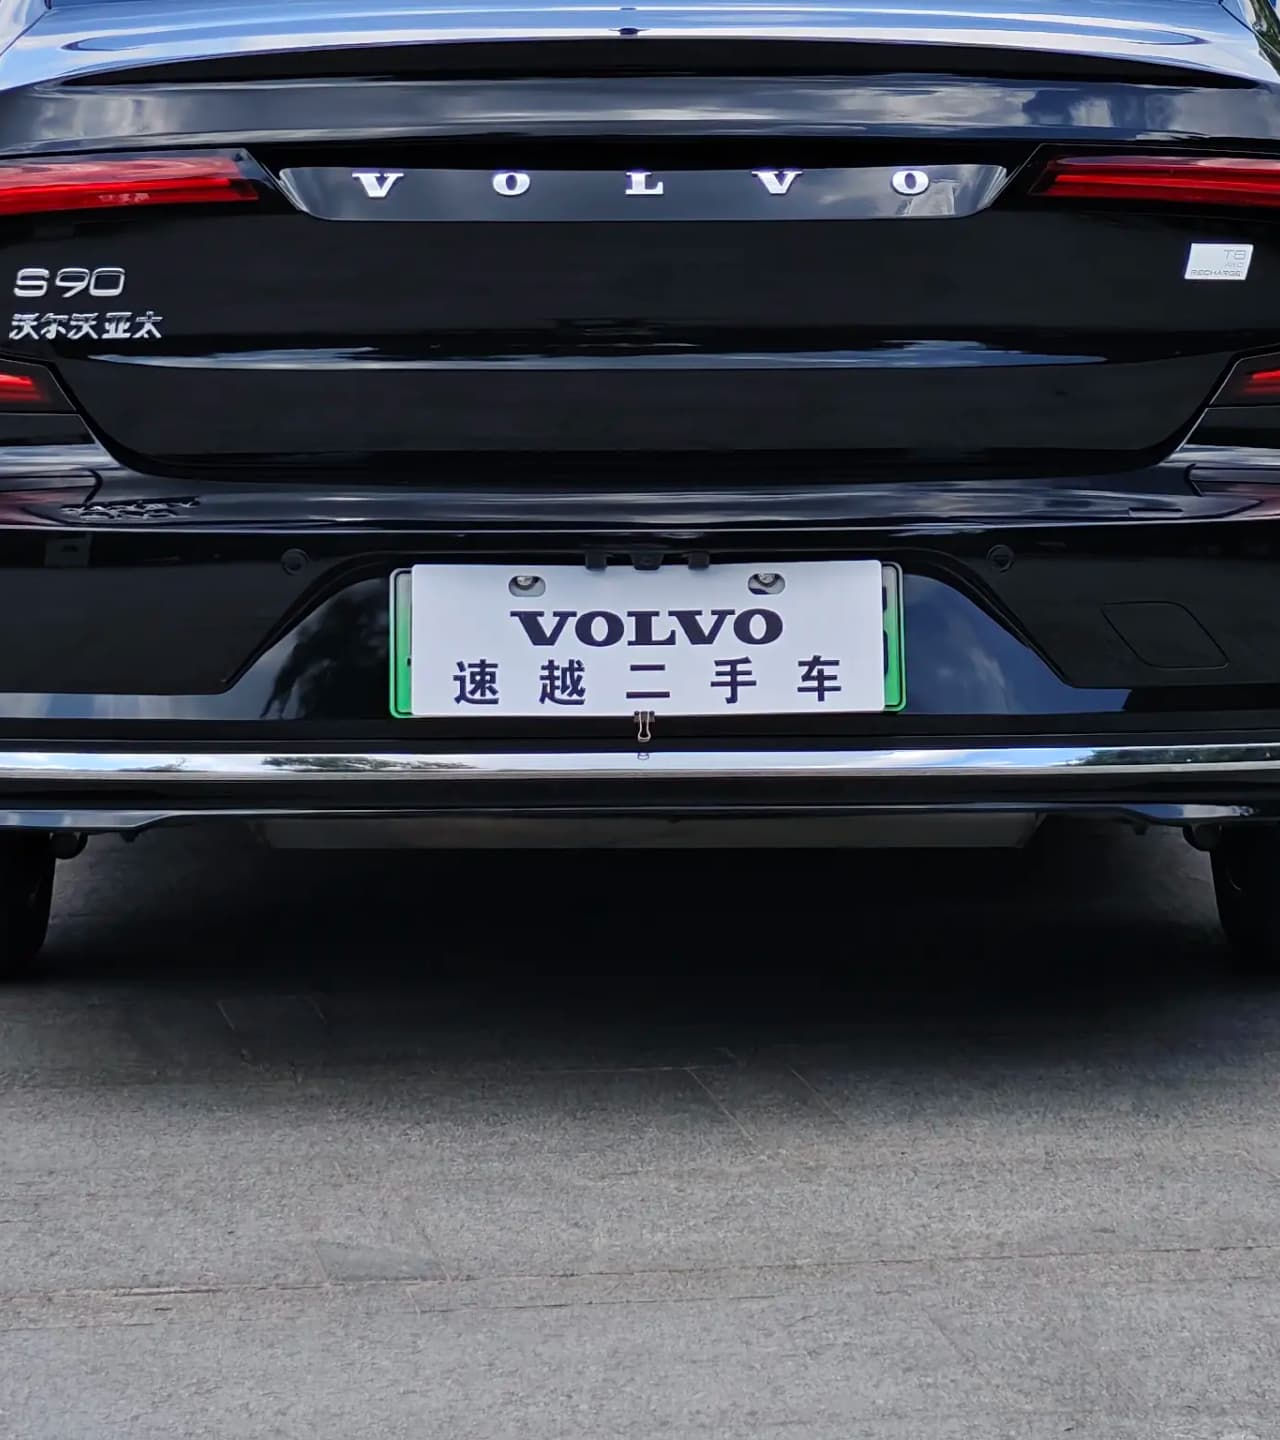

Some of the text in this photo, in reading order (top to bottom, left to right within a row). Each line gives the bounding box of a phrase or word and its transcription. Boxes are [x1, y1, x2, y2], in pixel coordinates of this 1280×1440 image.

[352, 170, 930, 198] VOLVO
[1223, 249, 1247, 260] T8
[13, 267, 126, 298] S90
[8, 311, 163, 340] 沃尔沃亚太
[509, 608, 784, 648] VOLVO
[452, 655, 842, 706] 速越二手车
